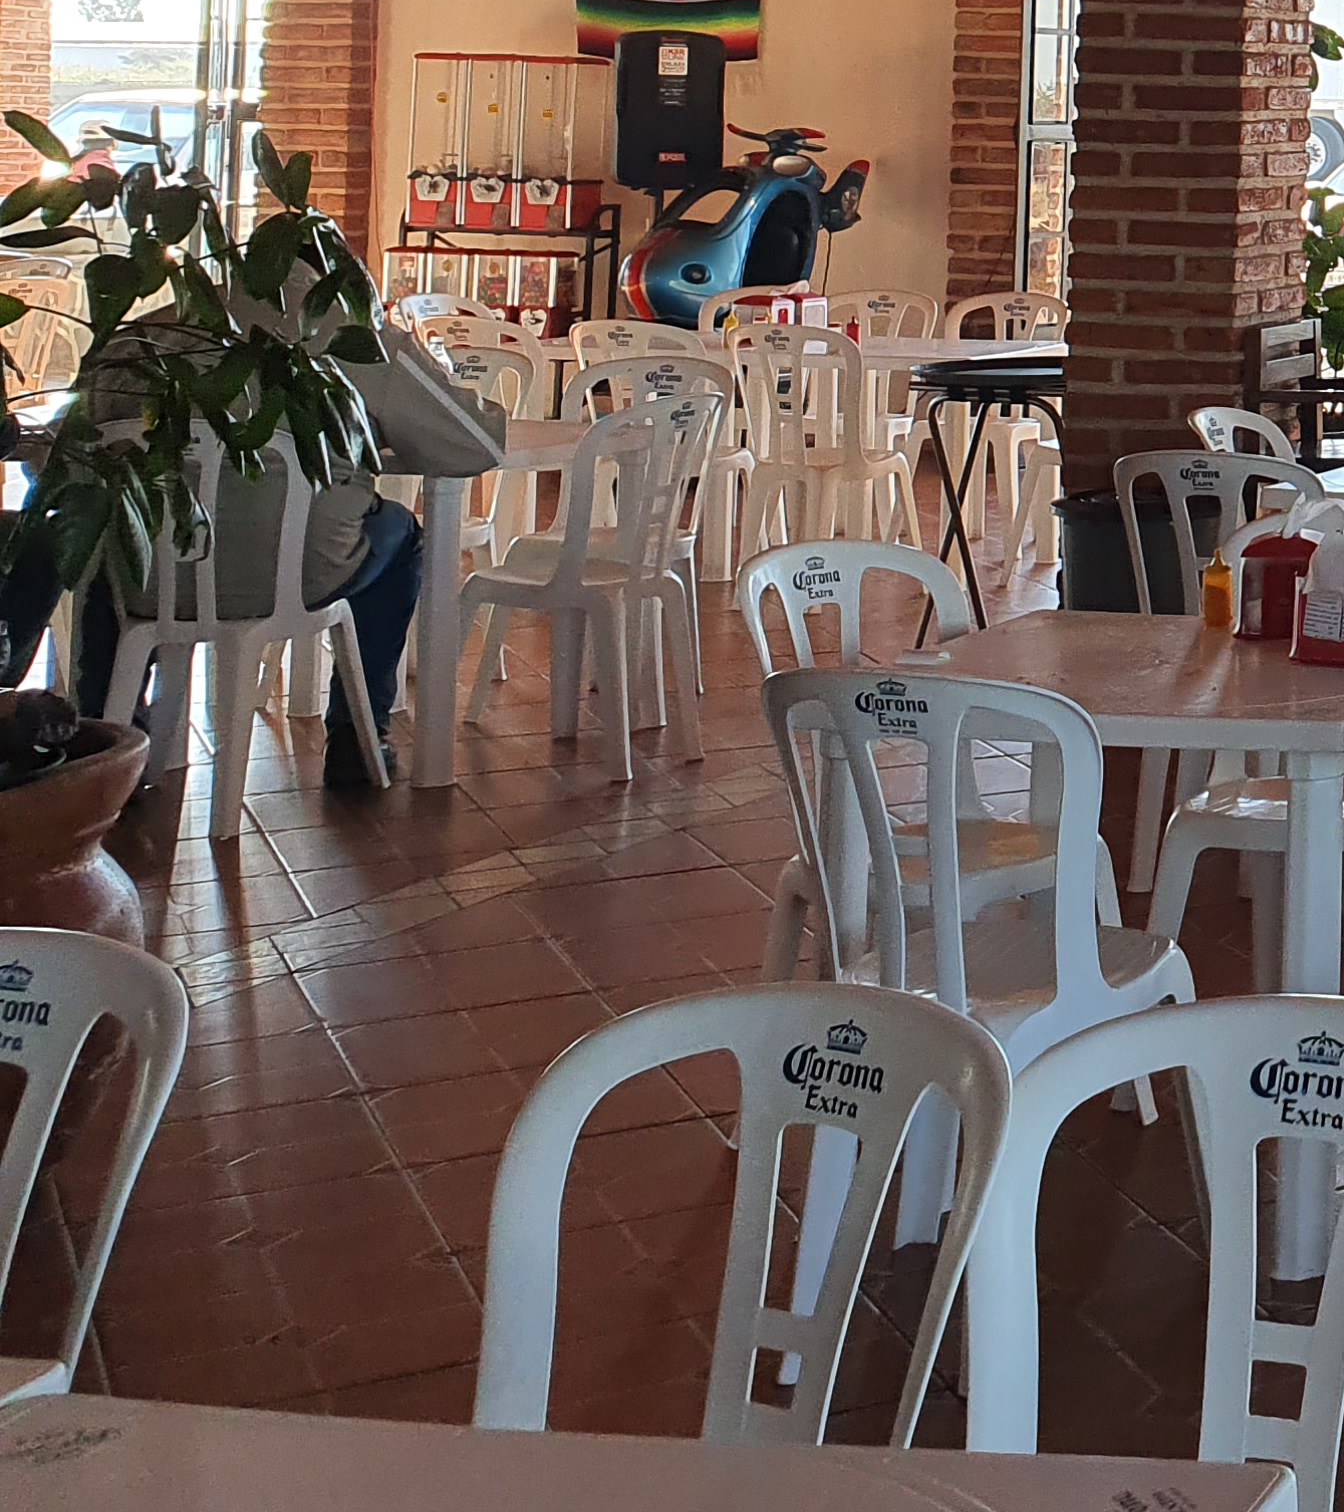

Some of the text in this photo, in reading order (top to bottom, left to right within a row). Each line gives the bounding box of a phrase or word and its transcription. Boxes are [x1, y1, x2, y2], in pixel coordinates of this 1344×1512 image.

[792, 570, 841, 592] Corona
[855, 691, 929, 716] Corona
[877, 712, 918, 728] Extra
[0, 998, 51, 1026] ona
[782, 1043, 884, 1094] Corona
[804, 1084, 859, 1119] Extra
[1281, 1097, 1344, 1131] Extra
